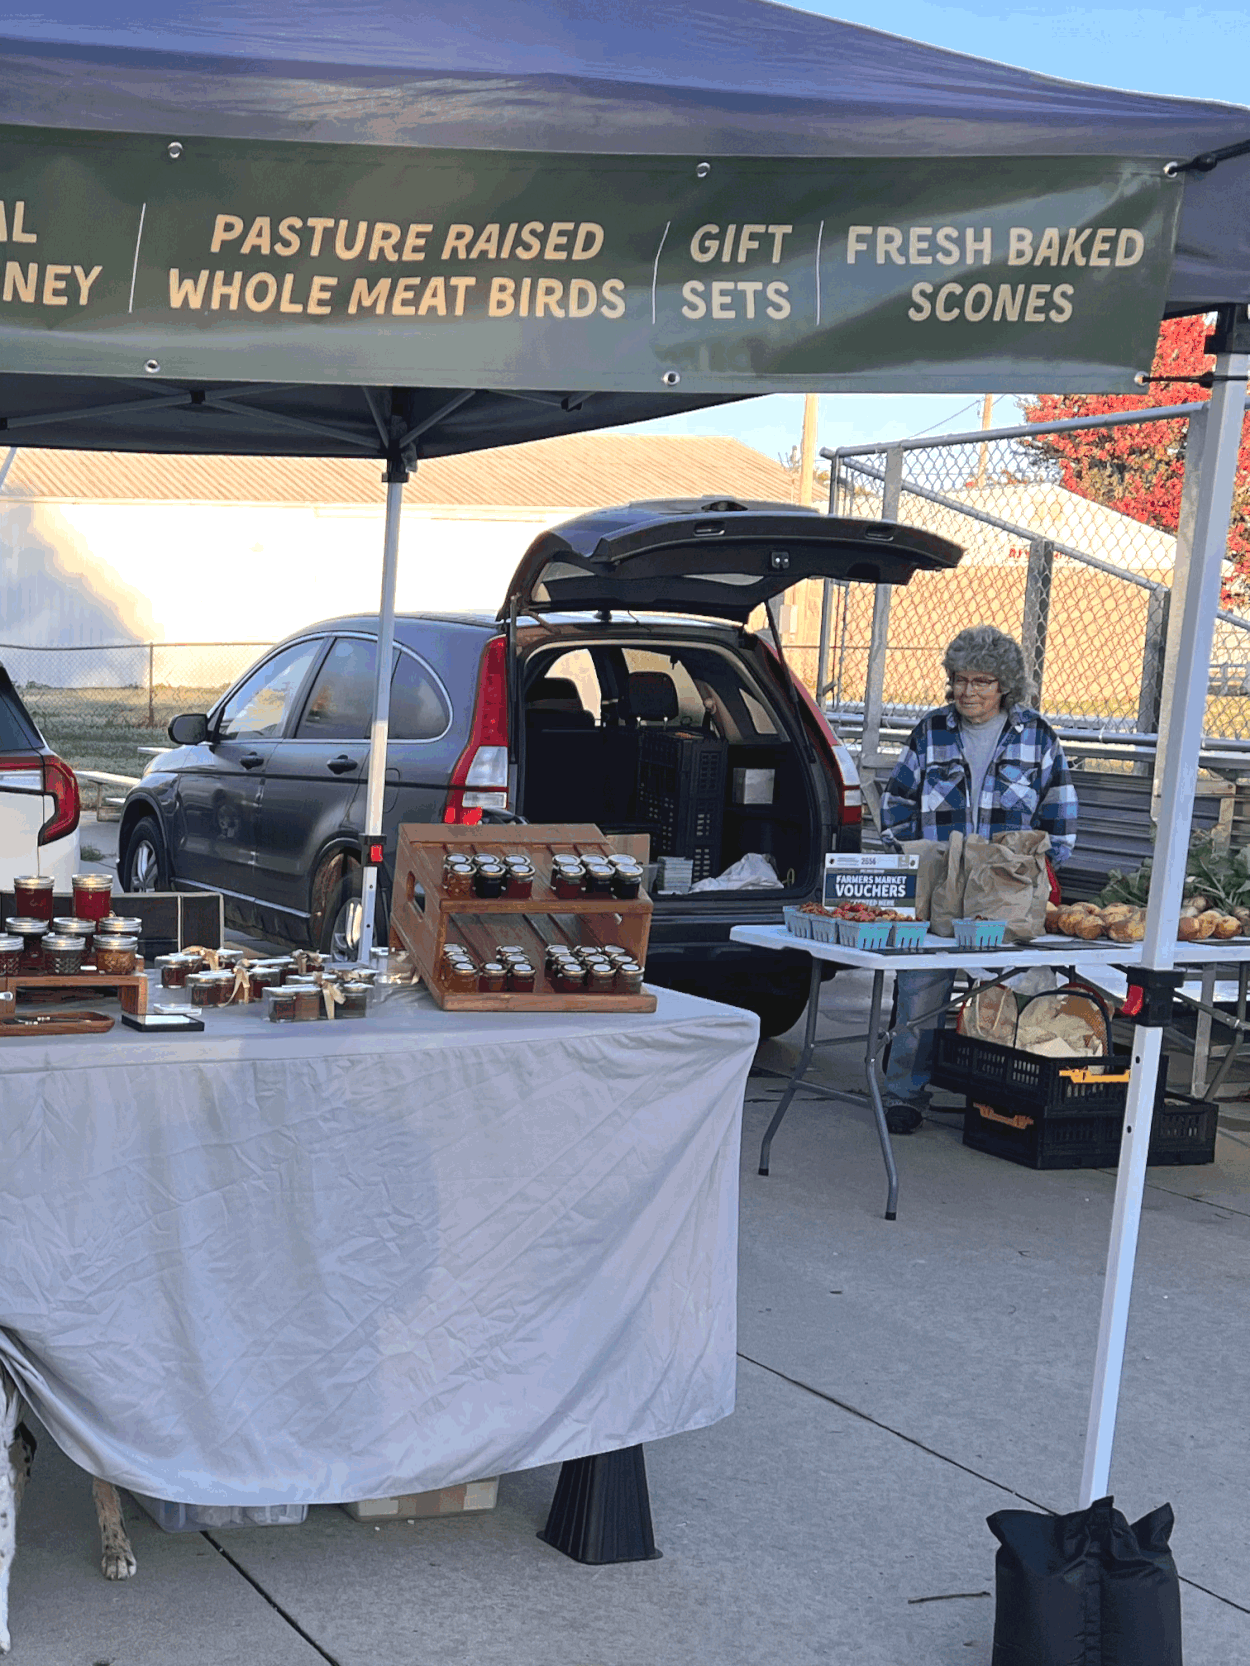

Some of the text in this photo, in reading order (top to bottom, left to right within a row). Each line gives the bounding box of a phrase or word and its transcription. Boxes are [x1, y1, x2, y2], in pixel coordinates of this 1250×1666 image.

[209, 213, 606, 262] PASTURE RAISED
[689, 223, 793, 264] GIFT
[846, 225, 1145, 268] FRESH BAKED
[168, 267, 627, 319] WHOLE MEAT BIRDS
[681, 281, 791, 320] SETS
[907, 282, 1075, 323] SCONES
[835, 884, 907, 898] VOUCHERS
[836, 875, 907, 884] FARMERS MARKET
